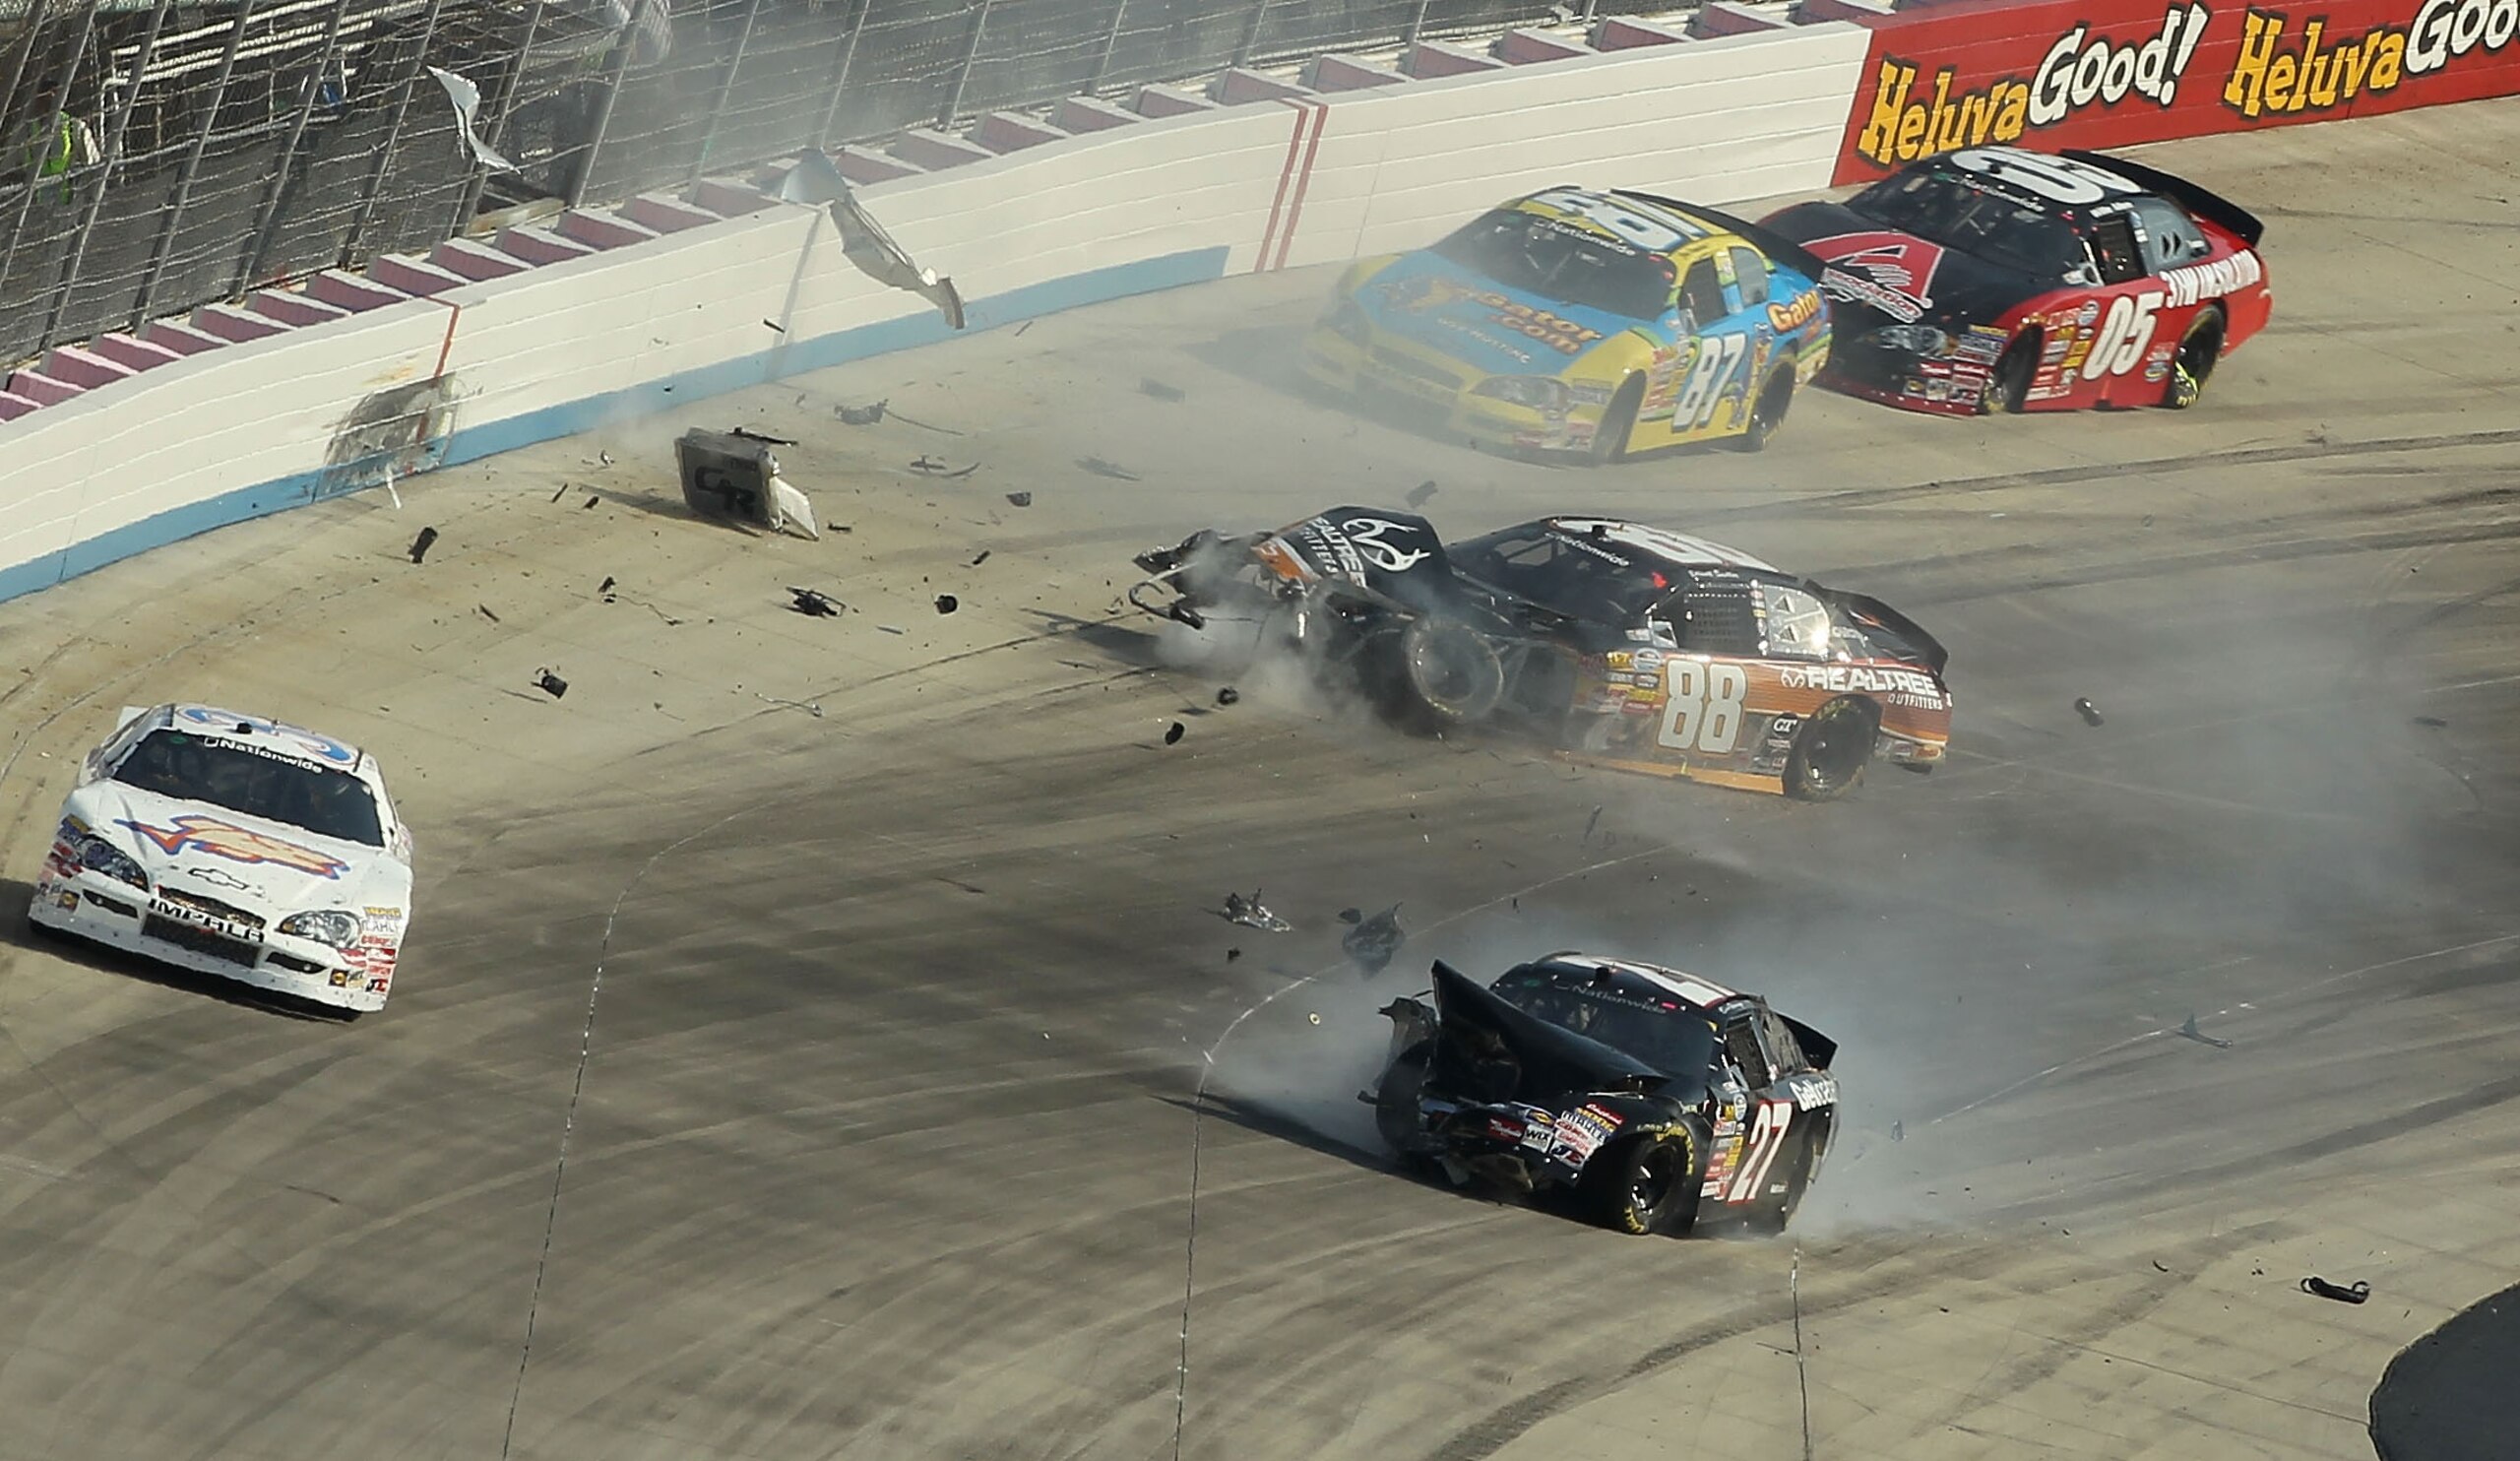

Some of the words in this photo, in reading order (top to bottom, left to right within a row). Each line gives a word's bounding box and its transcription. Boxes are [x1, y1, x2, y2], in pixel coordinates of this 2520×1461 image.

[2224, 11, 2403, 117] Heluva
[2405, 0, 2520, 75] Goo
[1858, 59, 2031, 164] Heluva
[2029, 3, 2209, 126] Good!
[1547, 221, 1636, 257] Nationwide
[1770, 290, 1821, 332] Gator
[2082, 291, 2165, 380] 05
[1671, 333, 1747, 432] 87
[1310, 515, 1369, 591] EALTREE
[1561, 535, 1631, 568] Nationwide
[1804, 665, 1942, 698] REALTREE
[1887, 692, 1944, 712] OUTFITTERS
[1658, 658, 1749, 755] 88
[219, 738, 323, 775] Nationwide
[149, 897, 266, 944] IMPALA
[1573, 985, 1668, 1015] Nationwide
[1527, 1129, 1550, 1143] WIX
[1726, 1100, 1794, 1205] 27
